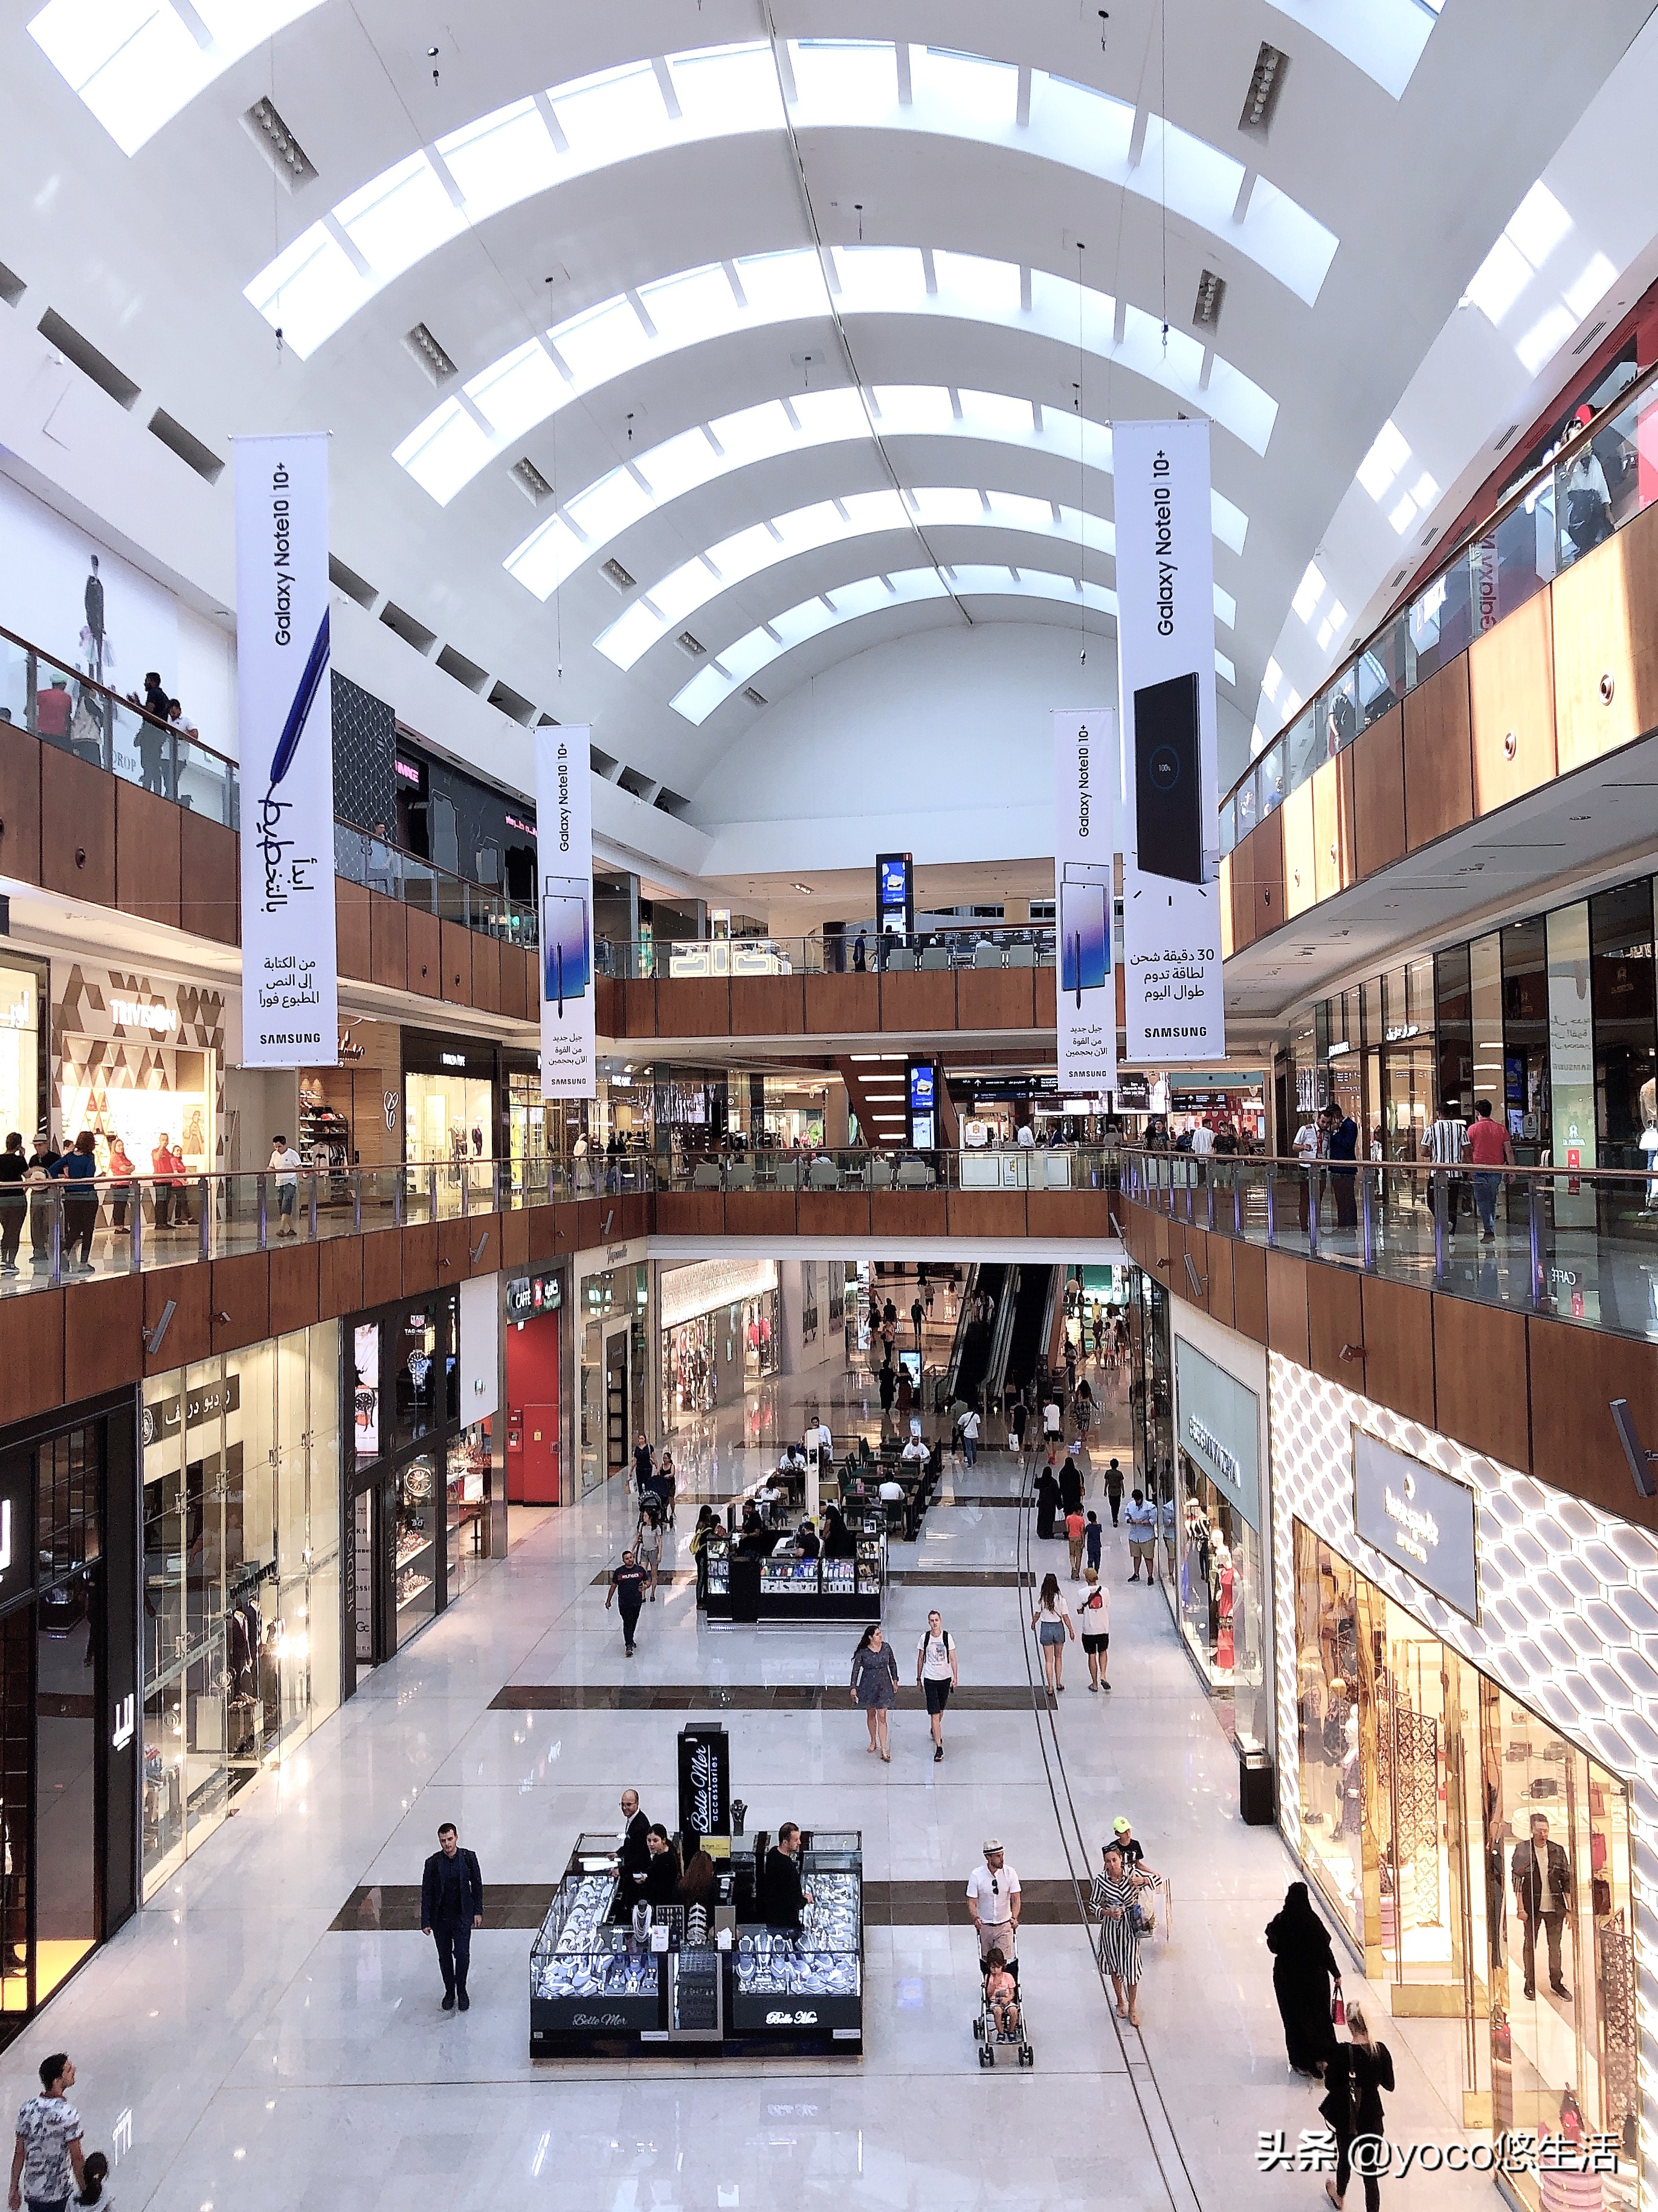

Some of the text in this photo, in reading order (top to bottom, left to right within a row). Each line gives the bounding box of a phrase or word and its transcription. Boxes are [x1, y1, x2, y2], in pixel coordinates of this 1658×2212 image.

[1153, 450, 1178, 636] Galaxy Note10 10+
[273, 462, 295, 646] Galaxy Note10 10+
[1079, 725, 1092, 837] Galaxy Note10 10+
[558, 743, 572, 852] Galaxy Note10 10+
[287, 858, 317, 890] ابدأ
[264, 956, 315, 971] من الكتابة
[1131, 949, 1214, 965] 30 دقيقة شحن
[266, 974, 312, 989] إلى النص
[1144, 966, 1204, 984] لطاقة تدوم
[282, 991, 319, 1008] المطبوع
[1144, 985, 1204, 1002] طوال اليوم
[1088, 1024, 1102, 1033] جيل
[1144, 1027, 1207, 1038] SAMSUNG
[260, 1033, 320, 1044] SAMSUNG
[569, 1033, 582, 1043] جيل
[1073, 1037, 1089, 1046] القوة
[555, 1046, 570, 1055] القوة
[1094, 1047, 1108, 1056] الآن
[575, 1056, 587, 1065] الآن
[691, 1745, 708, 1832] Belle Mer
